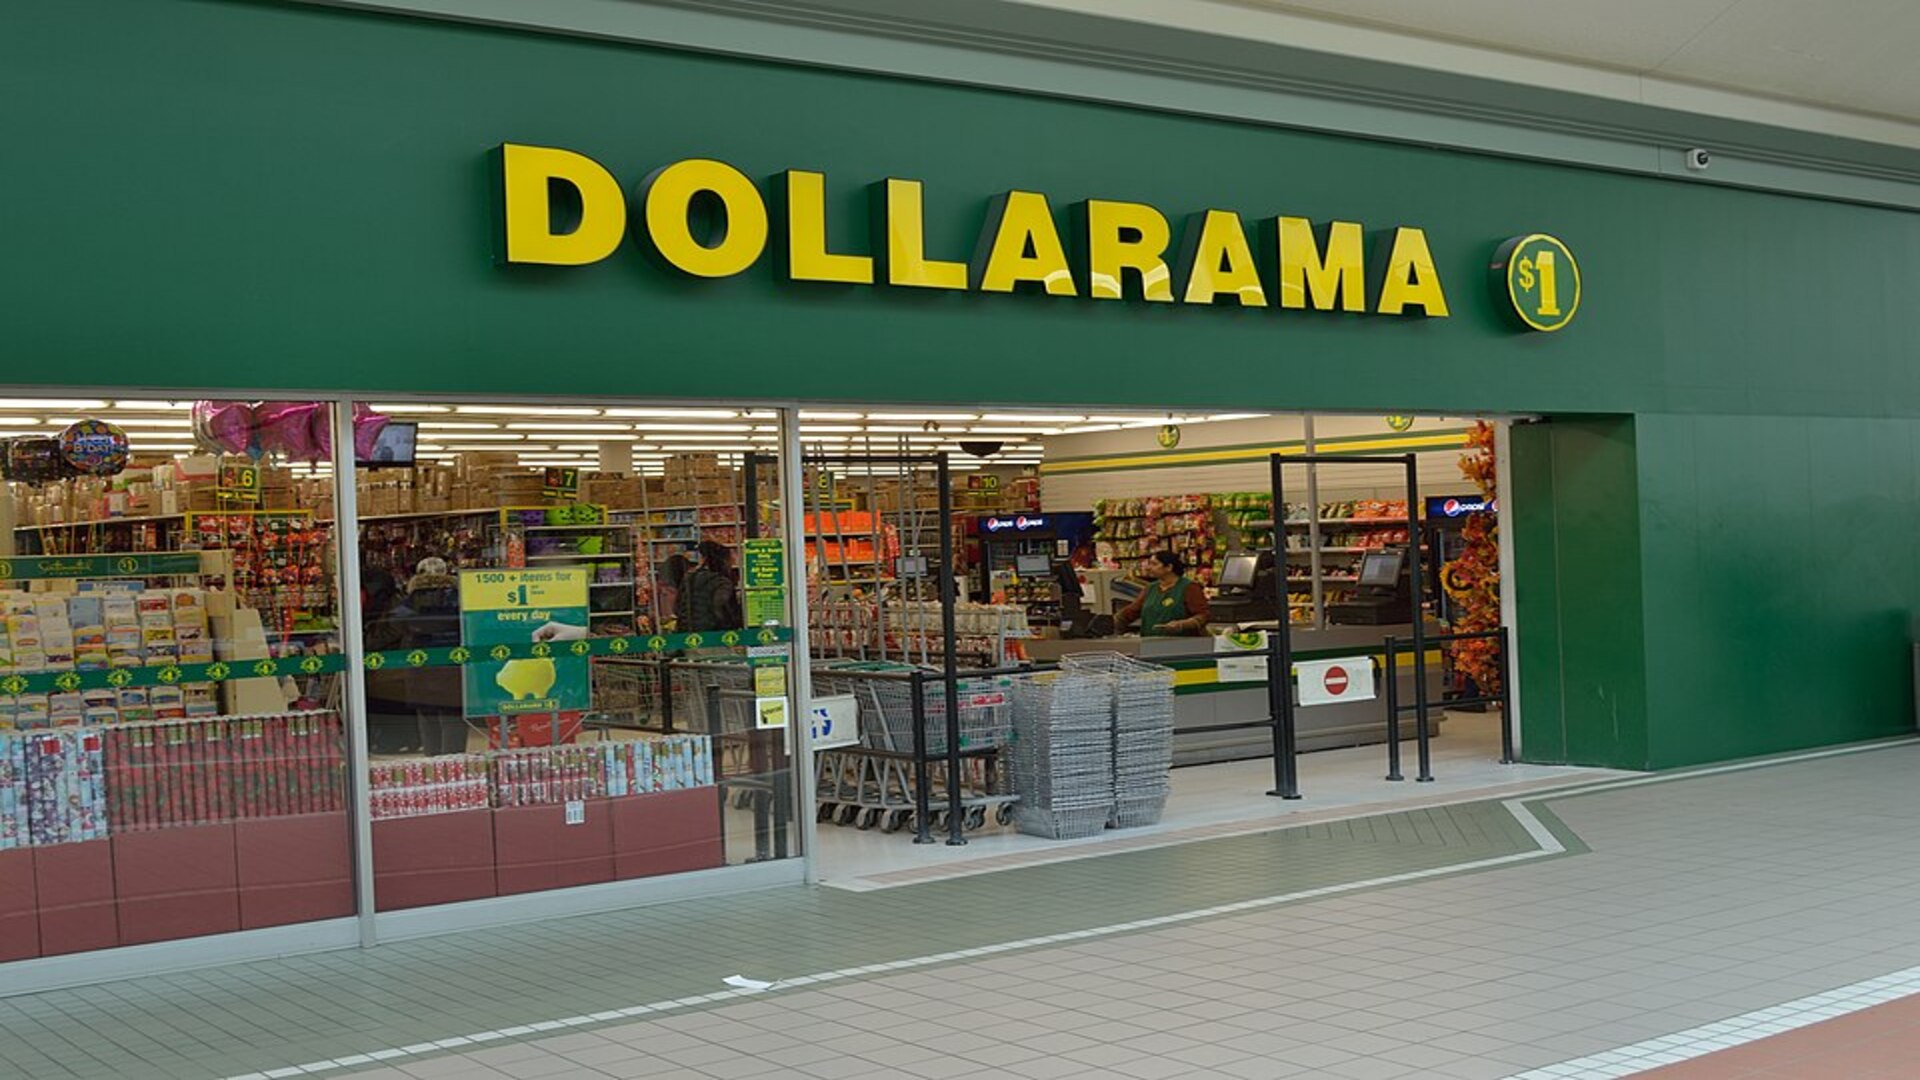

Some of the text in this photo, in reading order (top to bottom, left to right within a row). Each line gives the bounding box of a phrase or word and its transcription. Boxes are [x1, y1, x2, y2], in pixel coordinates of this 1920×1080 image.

[503, 143, 1449, 317] DOLLARAMA
[1518, 250, 1561, 316] $1
[242, 469, 253, 487] 6
[564, 471, 575, 487] 7
[983, 476, 998, 489] 10
[475, 574, 505, 583] 1500
[520, 573, 552, 582] items
[555, 571, 573, 580] for
[507, 584, 527, 605] $1
[497, 609, 550, 621] every day
